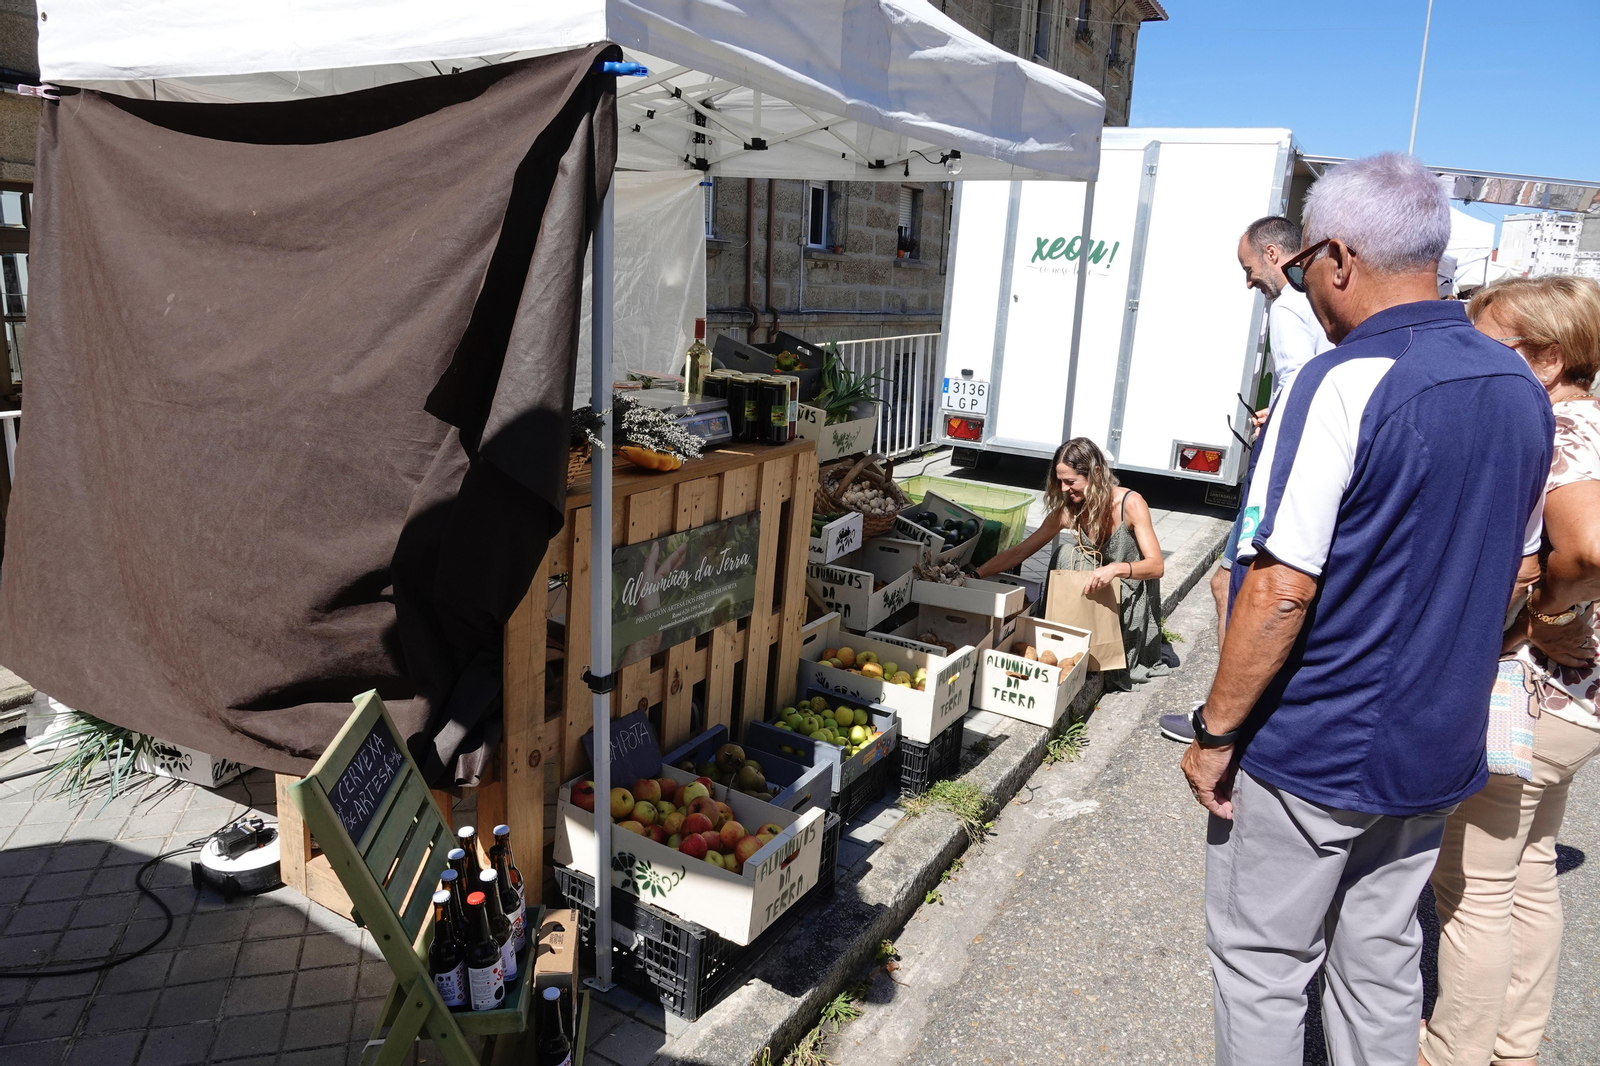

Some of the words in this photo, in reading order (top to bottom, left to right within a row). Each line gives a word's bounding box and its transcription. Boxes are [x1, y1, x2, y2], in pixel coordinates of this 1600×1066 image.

[953, 382, 985, 397] 3136
[947, 396, 978, 411] LGP
[622, 570, 692, 607] Aloumiños
[695, 556, 714, 583] da
[716, 547, 751, 576] Terra
[823, 585, 835, 600] DA
[1006, 677, 1020, 690] DA
[940, 689, 963, 718] TERRA
[992, 686, 1036, 709] TERRA
[609, 721, 652, 763] MPOTA
[338, 733, 385, 804] CERVEXA
[778, 865, 792, 892] DA
[765, 873, 804, 923] TERRA
